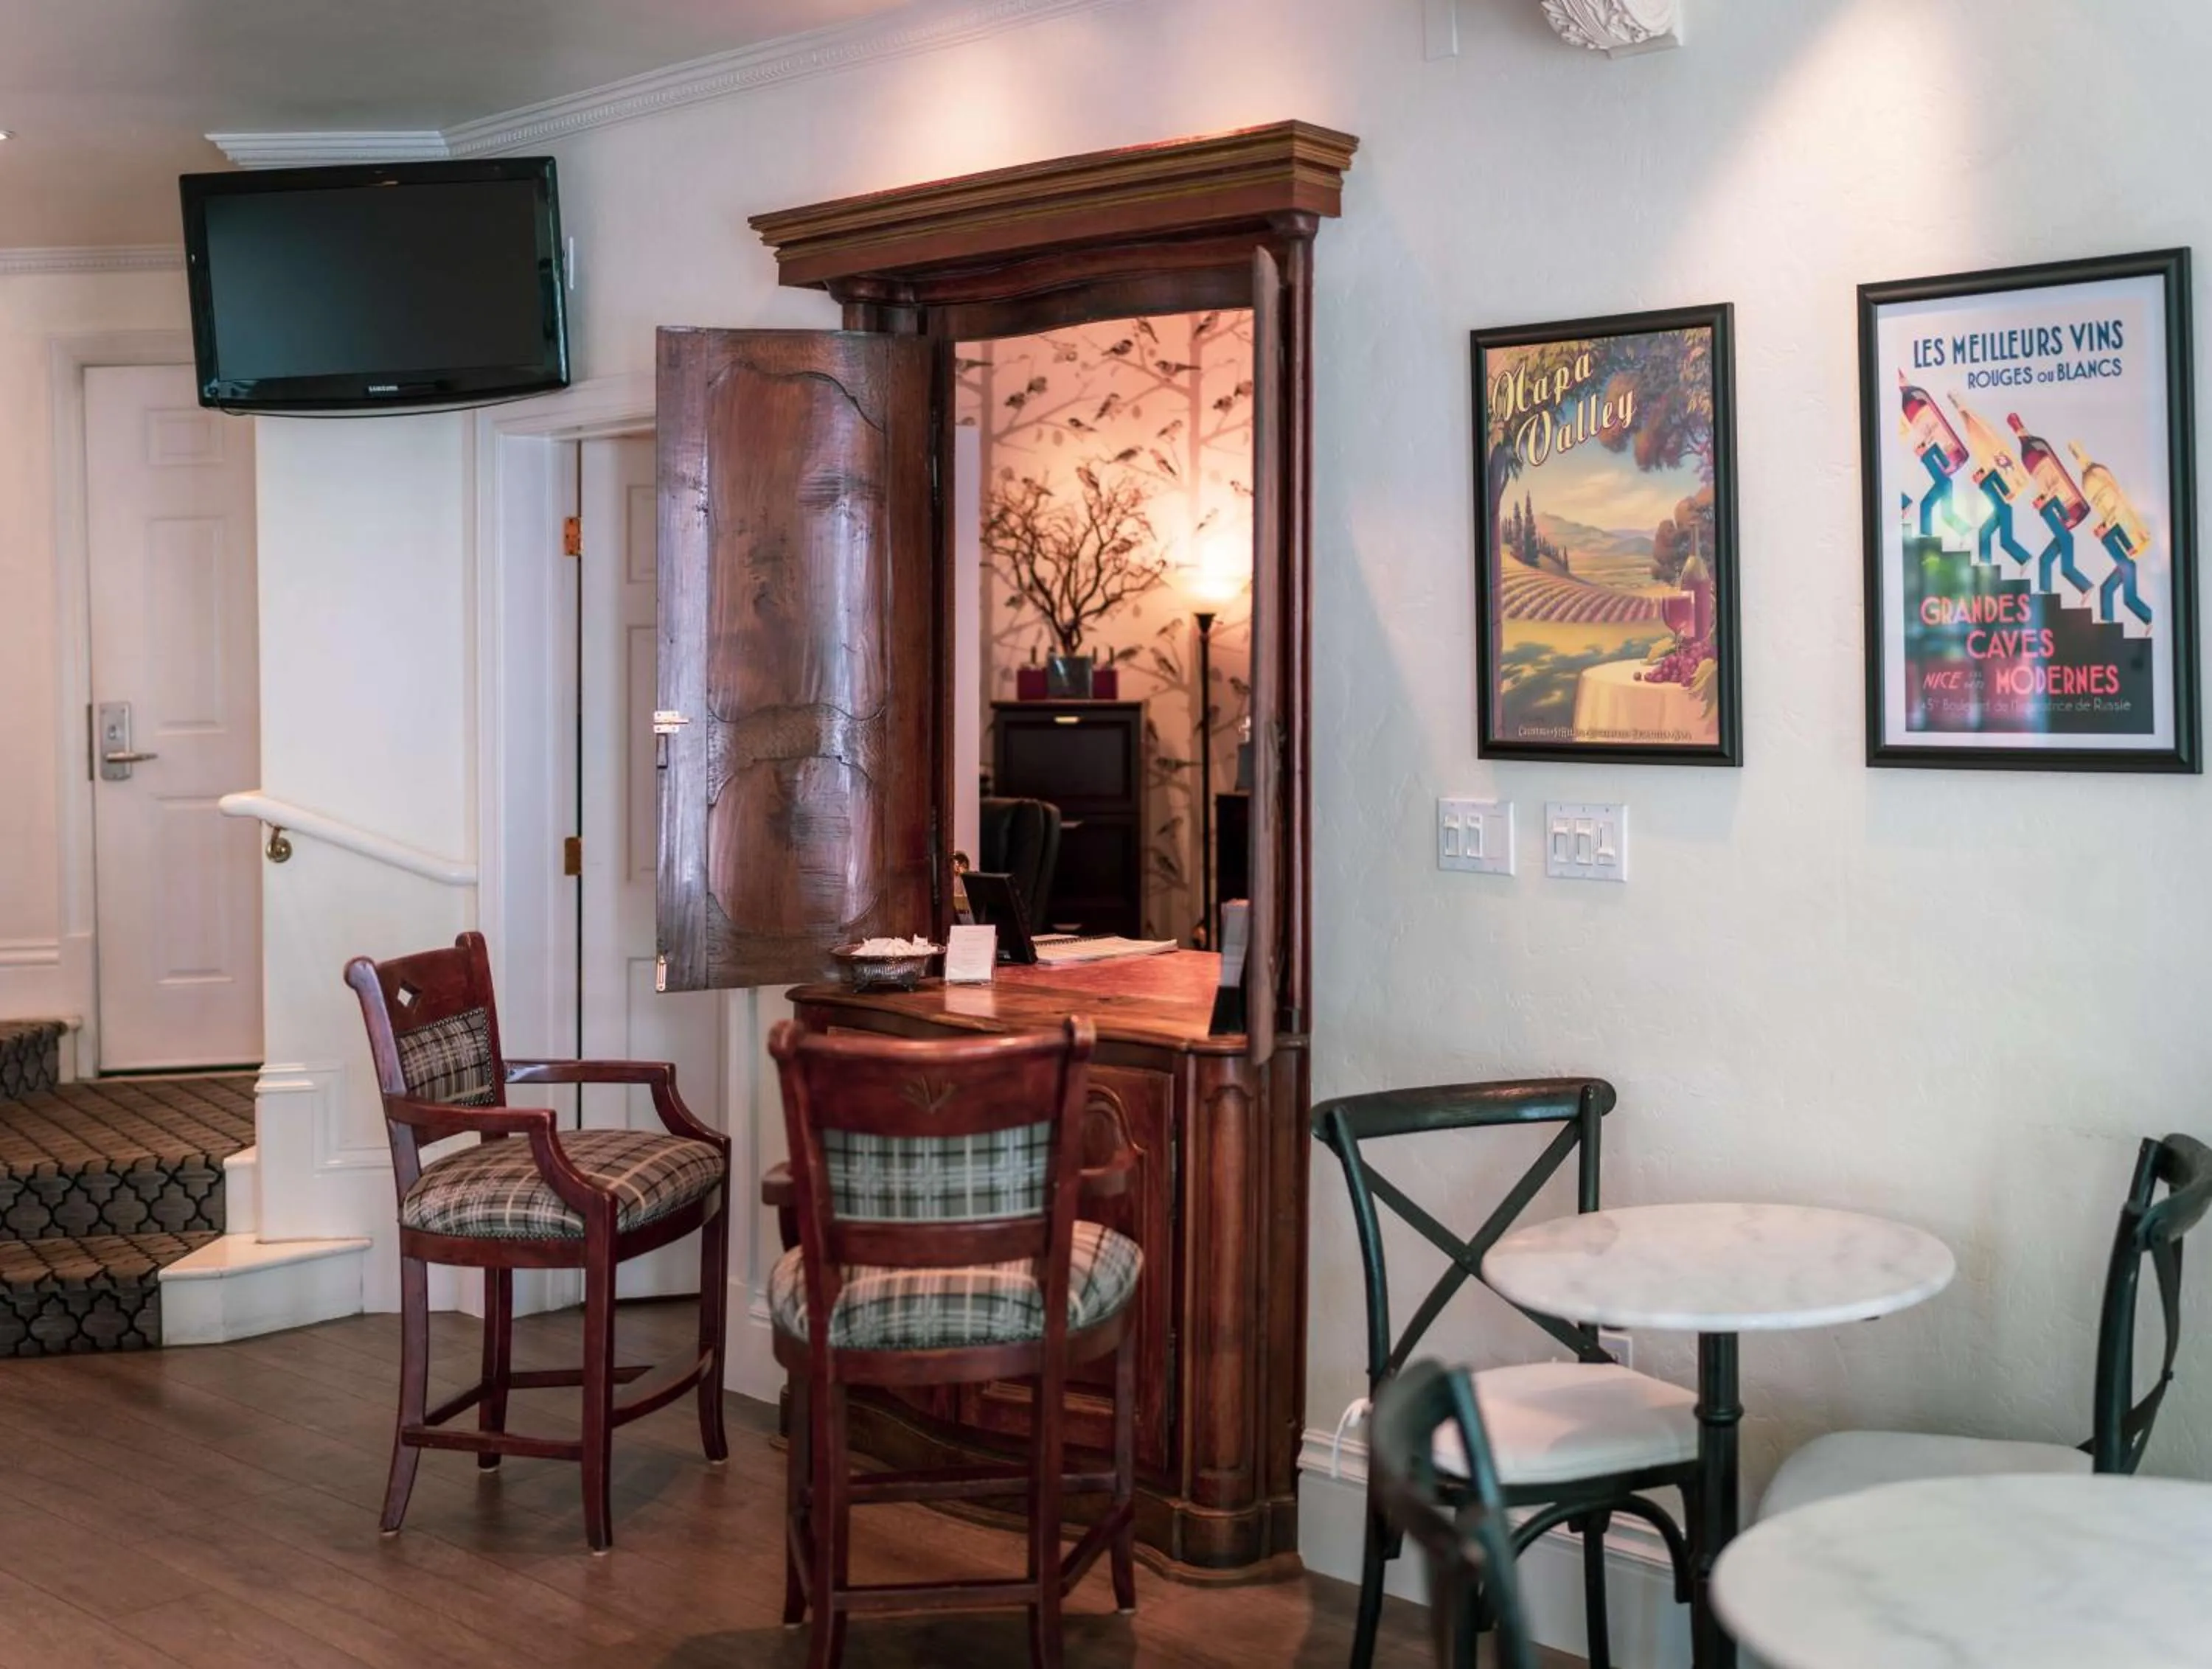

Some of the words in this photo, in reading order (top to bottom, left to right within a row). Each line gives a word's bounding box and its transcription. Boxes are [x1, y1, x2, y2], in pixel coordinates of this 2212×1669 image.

[1913, 338, 1945, 368] LES
[1952, 326, 2062, 364] MEILLEURS
[2069, 320, 2124, 352] VINS
[1492, 352, 1593, 422] Napa
[1967, 366, 2033, 390] ROUGES
[2056, 358, 2124, 382] BLANCS
[1514, 388, 1638, 467] Valley
[1920, 593, 2031, 625] GRANDES
[1966, 629, 2054, 660] CAVES
[1922, 670, 1964, 691] NICE
[1995, 665, 2120, 694] MODERNES
[2075, 697, 2090, 712] de
